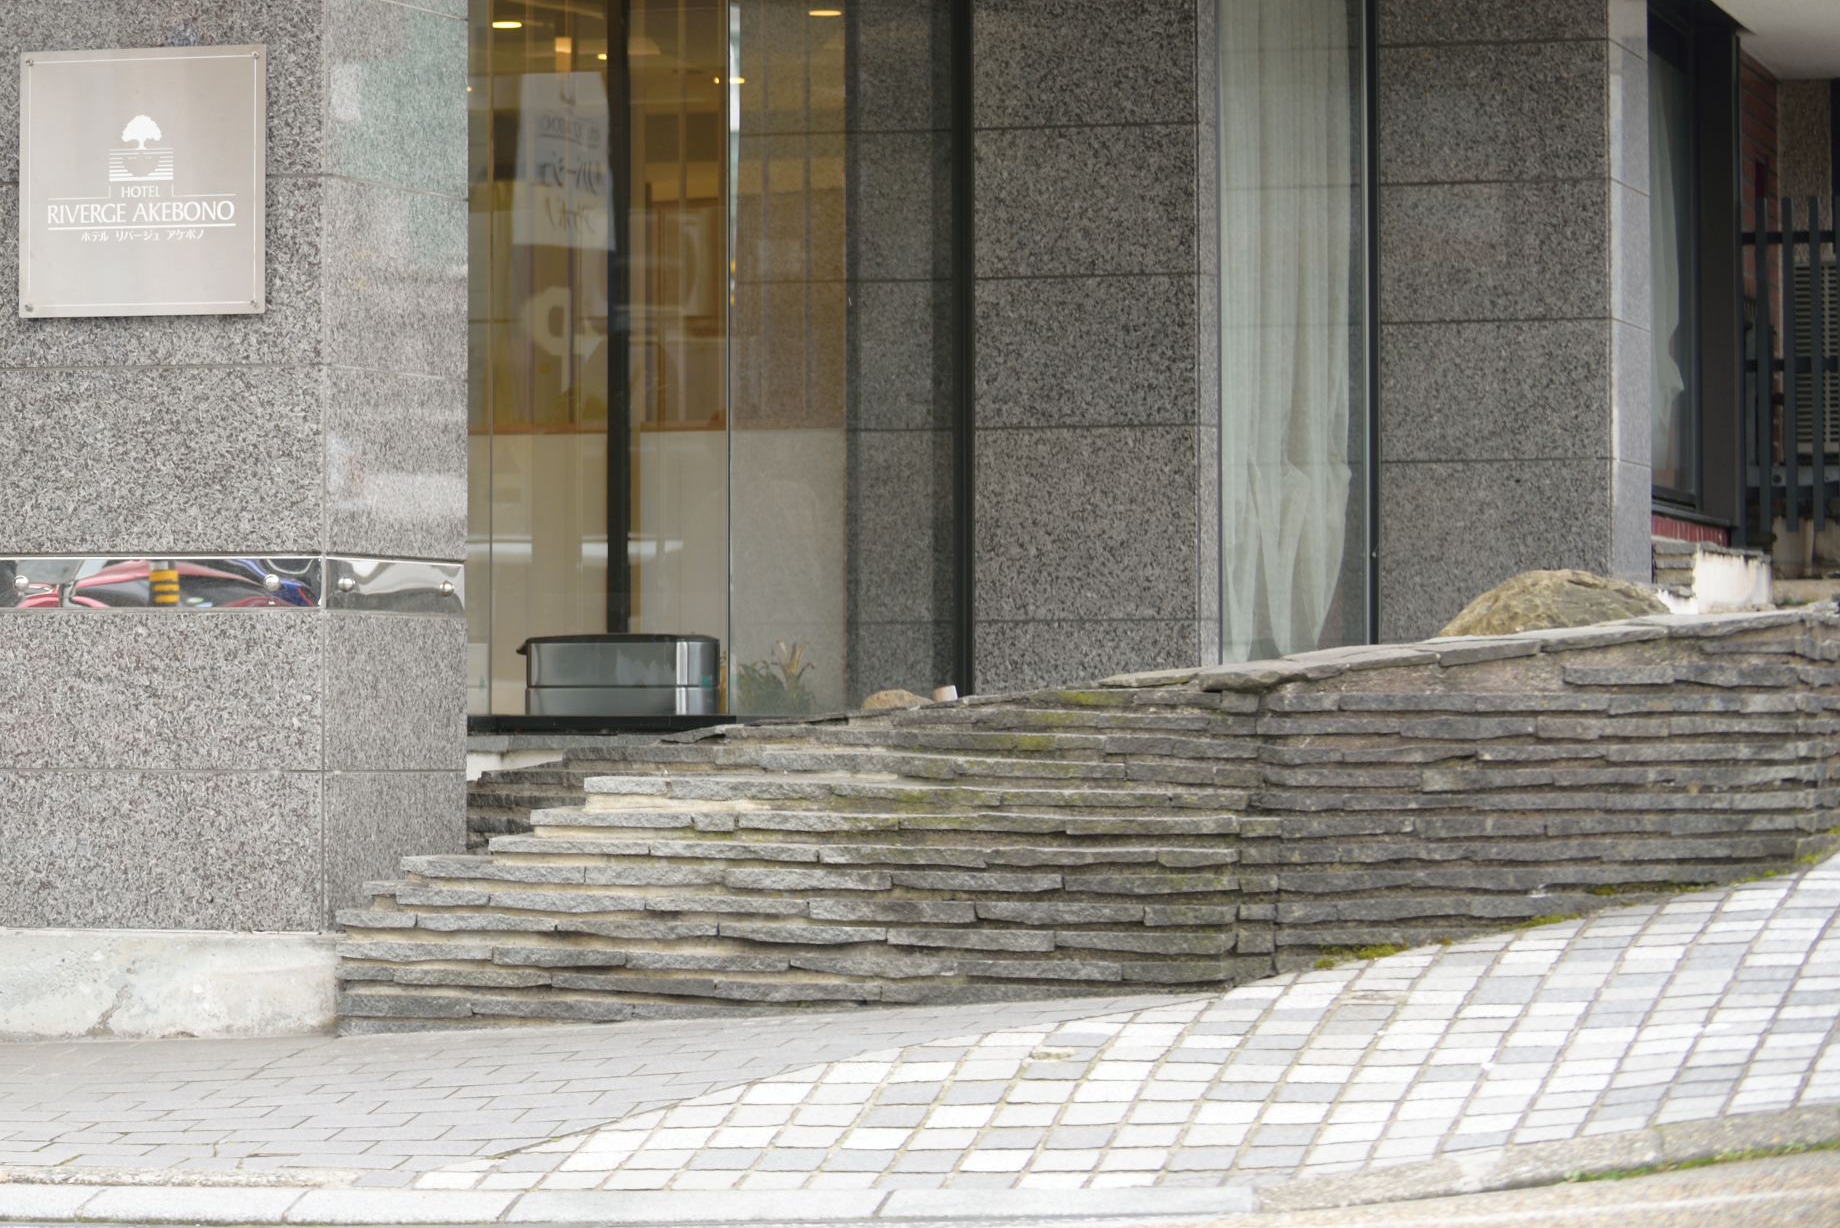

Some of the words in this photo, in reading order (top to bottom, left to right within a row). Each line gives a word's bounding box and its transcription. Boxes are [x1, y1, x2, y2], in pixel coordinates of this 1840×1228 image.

[120, 185, 161, 199] HOTEL
[47, 203, 127, 224] RIVERGE
[132, 200, 235, 222] AKEBONO
[80, 230, 109, 243] ホテル
[115, 229, 161, 242] リバージュ
[166, 228, 205, 241] アケボノ
